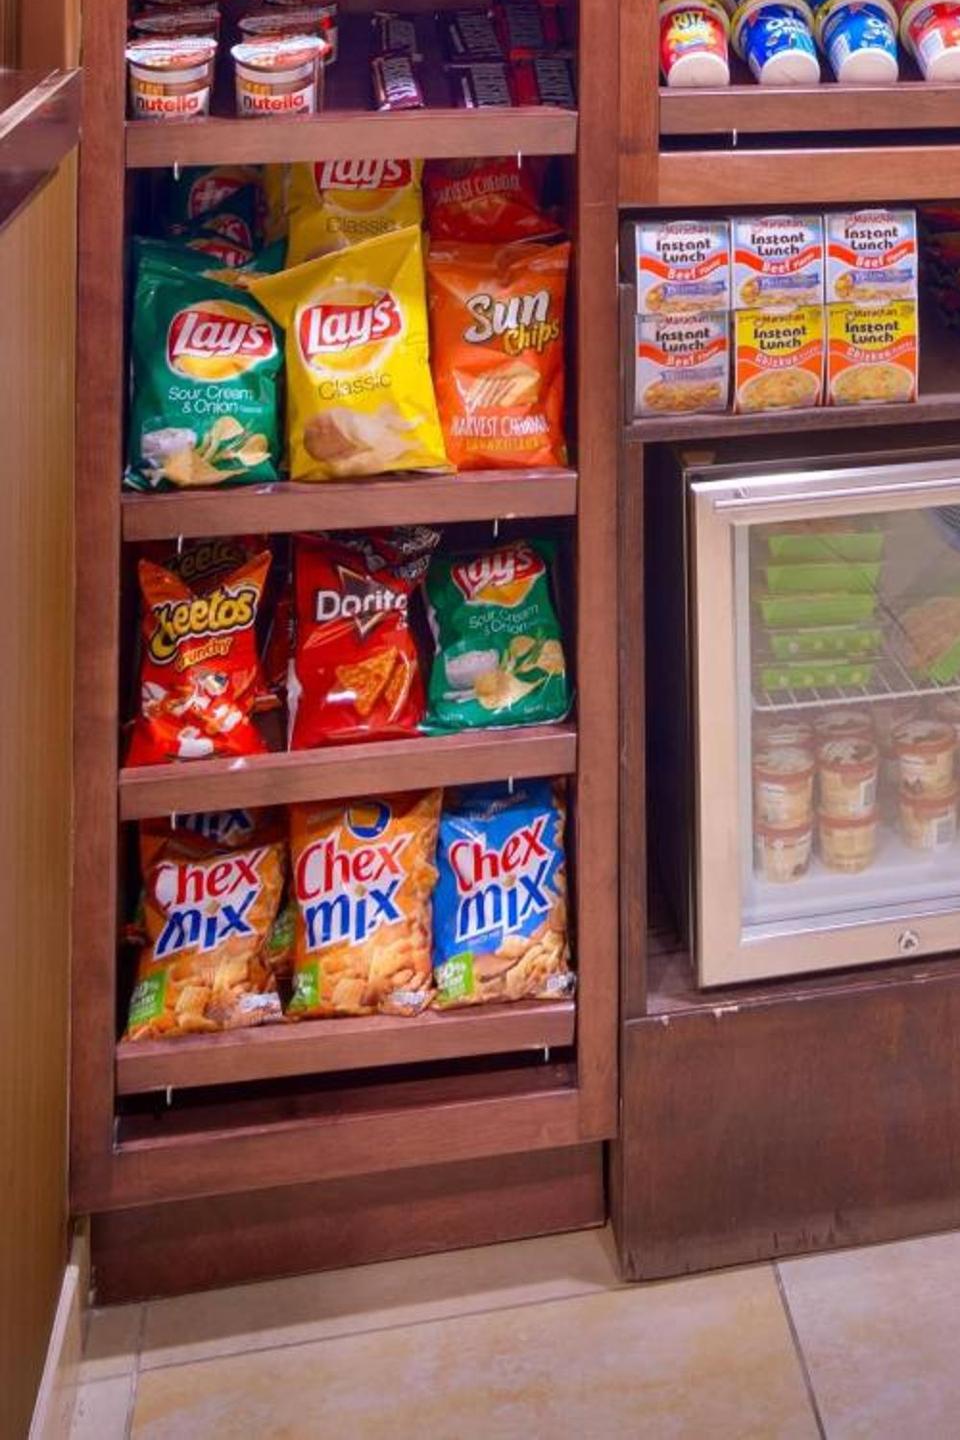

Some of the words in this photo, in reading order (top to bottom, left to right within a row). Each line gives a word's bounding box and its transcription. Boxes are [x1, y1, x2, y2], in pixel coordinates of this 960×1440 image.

[135, 94, 199, 112] nutella
[243, 94, 304, 112] nutella
[751, 231, 806, 246] Instant
[844, 226, 899, 240] Instant
[656, 238, 712, 252] Instant
[757, 244, 800, 257] Lunch
[851, 239, 894, 251] Lunch
[663, 251, 706, 263] Lunch
[464, 288, 550, 344] Sun
[656, 327, 711, 342] Instant
[753, 325, 808, 340] Instant
[845, 320, 901, 334] Instant
[503, 319, 560, 356] Chips
[759, 338, 802, 351] Lunch
[852, 332, 894, 345] Lunch
[662, 340, 705, 353] Lunch
[168, 386, 202, 401] Sour
[206, 385, 253, 401] Cream
[318, 373, 392, 401] Classic
[194, 399, 238, 414] Onion
[468, 610, 494, 630] Sour
[499, 604, 539, 623] Cream
[450, 817, 546, 892] Chex
[298, 834, 408, 901] Chex
[152, 846, 269, 911] Chex
[459, 859, 549, 937] mix
[305, 879, 400, 948] mix
